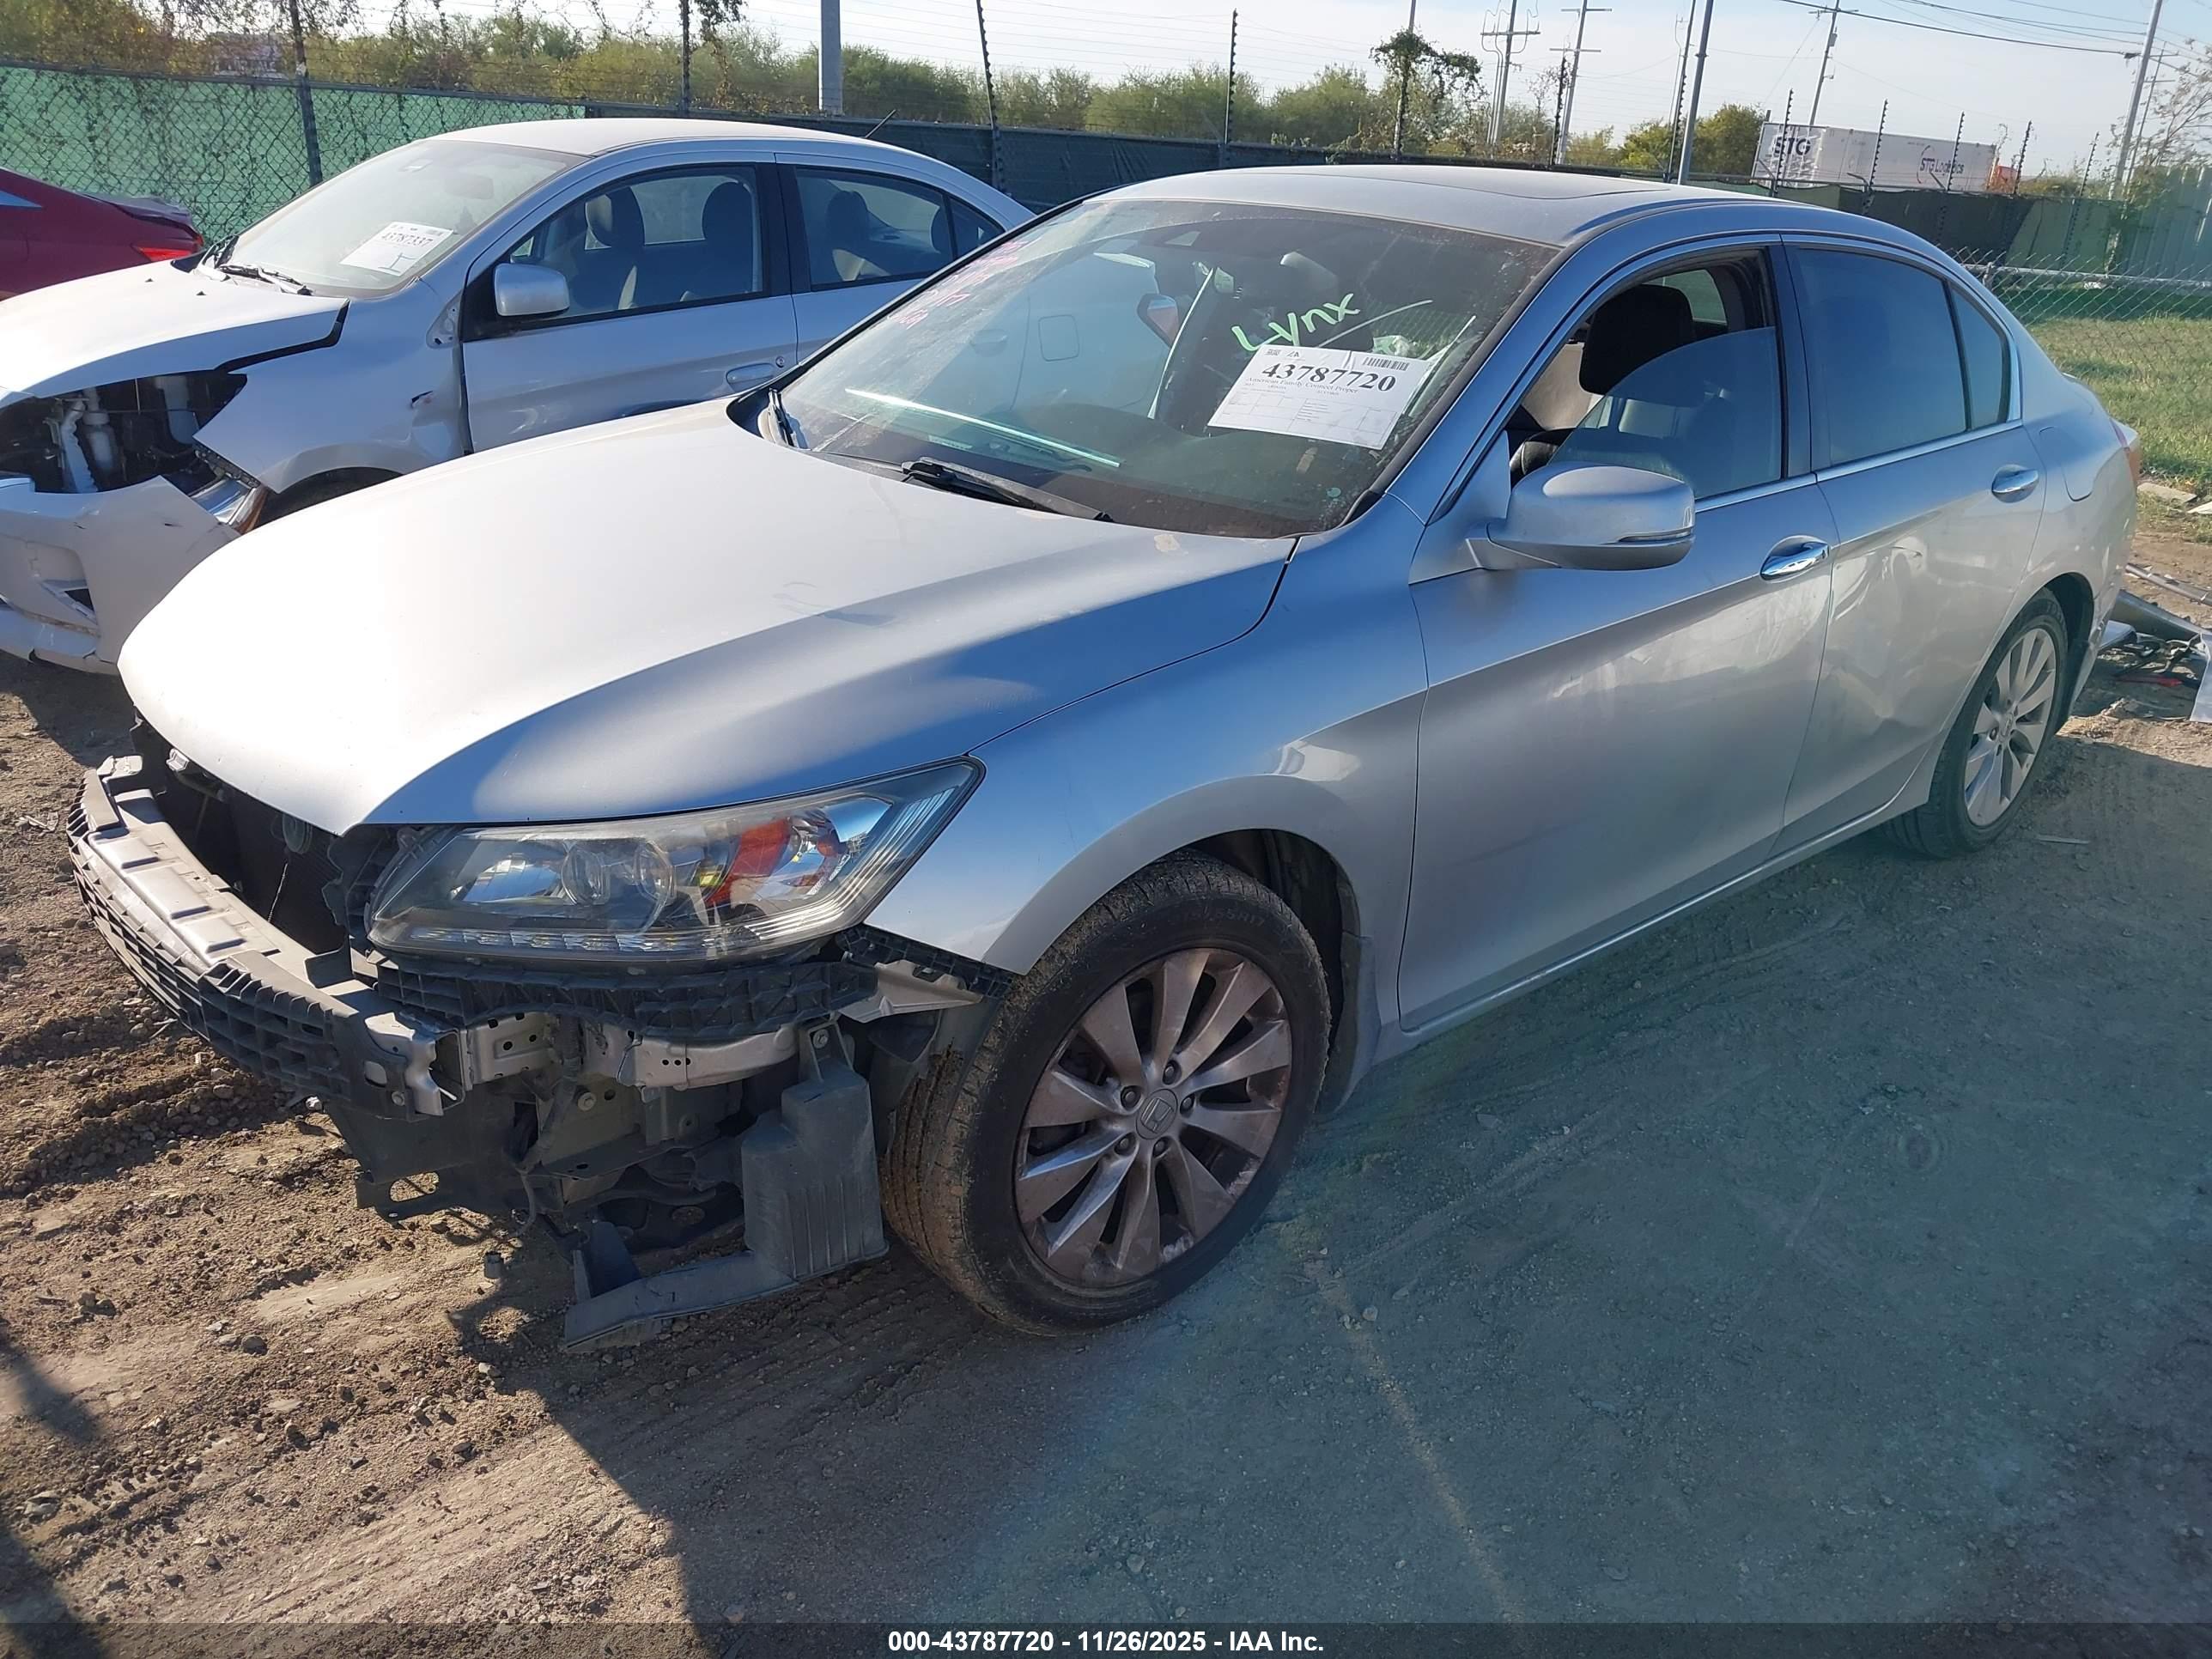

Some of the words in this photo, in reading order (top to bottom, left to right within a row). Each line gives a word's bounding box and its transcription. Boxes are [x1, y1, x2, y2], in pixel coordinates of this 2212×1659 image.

[1771, 137, 1811, 155] STG
[1920, 158, 1936, 173] STG
[1935, 159, 1965, 176] Logiics
[1231, 293, 1361, 351] Lynx
[1261, 362, 1396, 392] 43787720
[1279, 379, 1303, 387] Family
[1305, 382, 1333, 391] Connect
